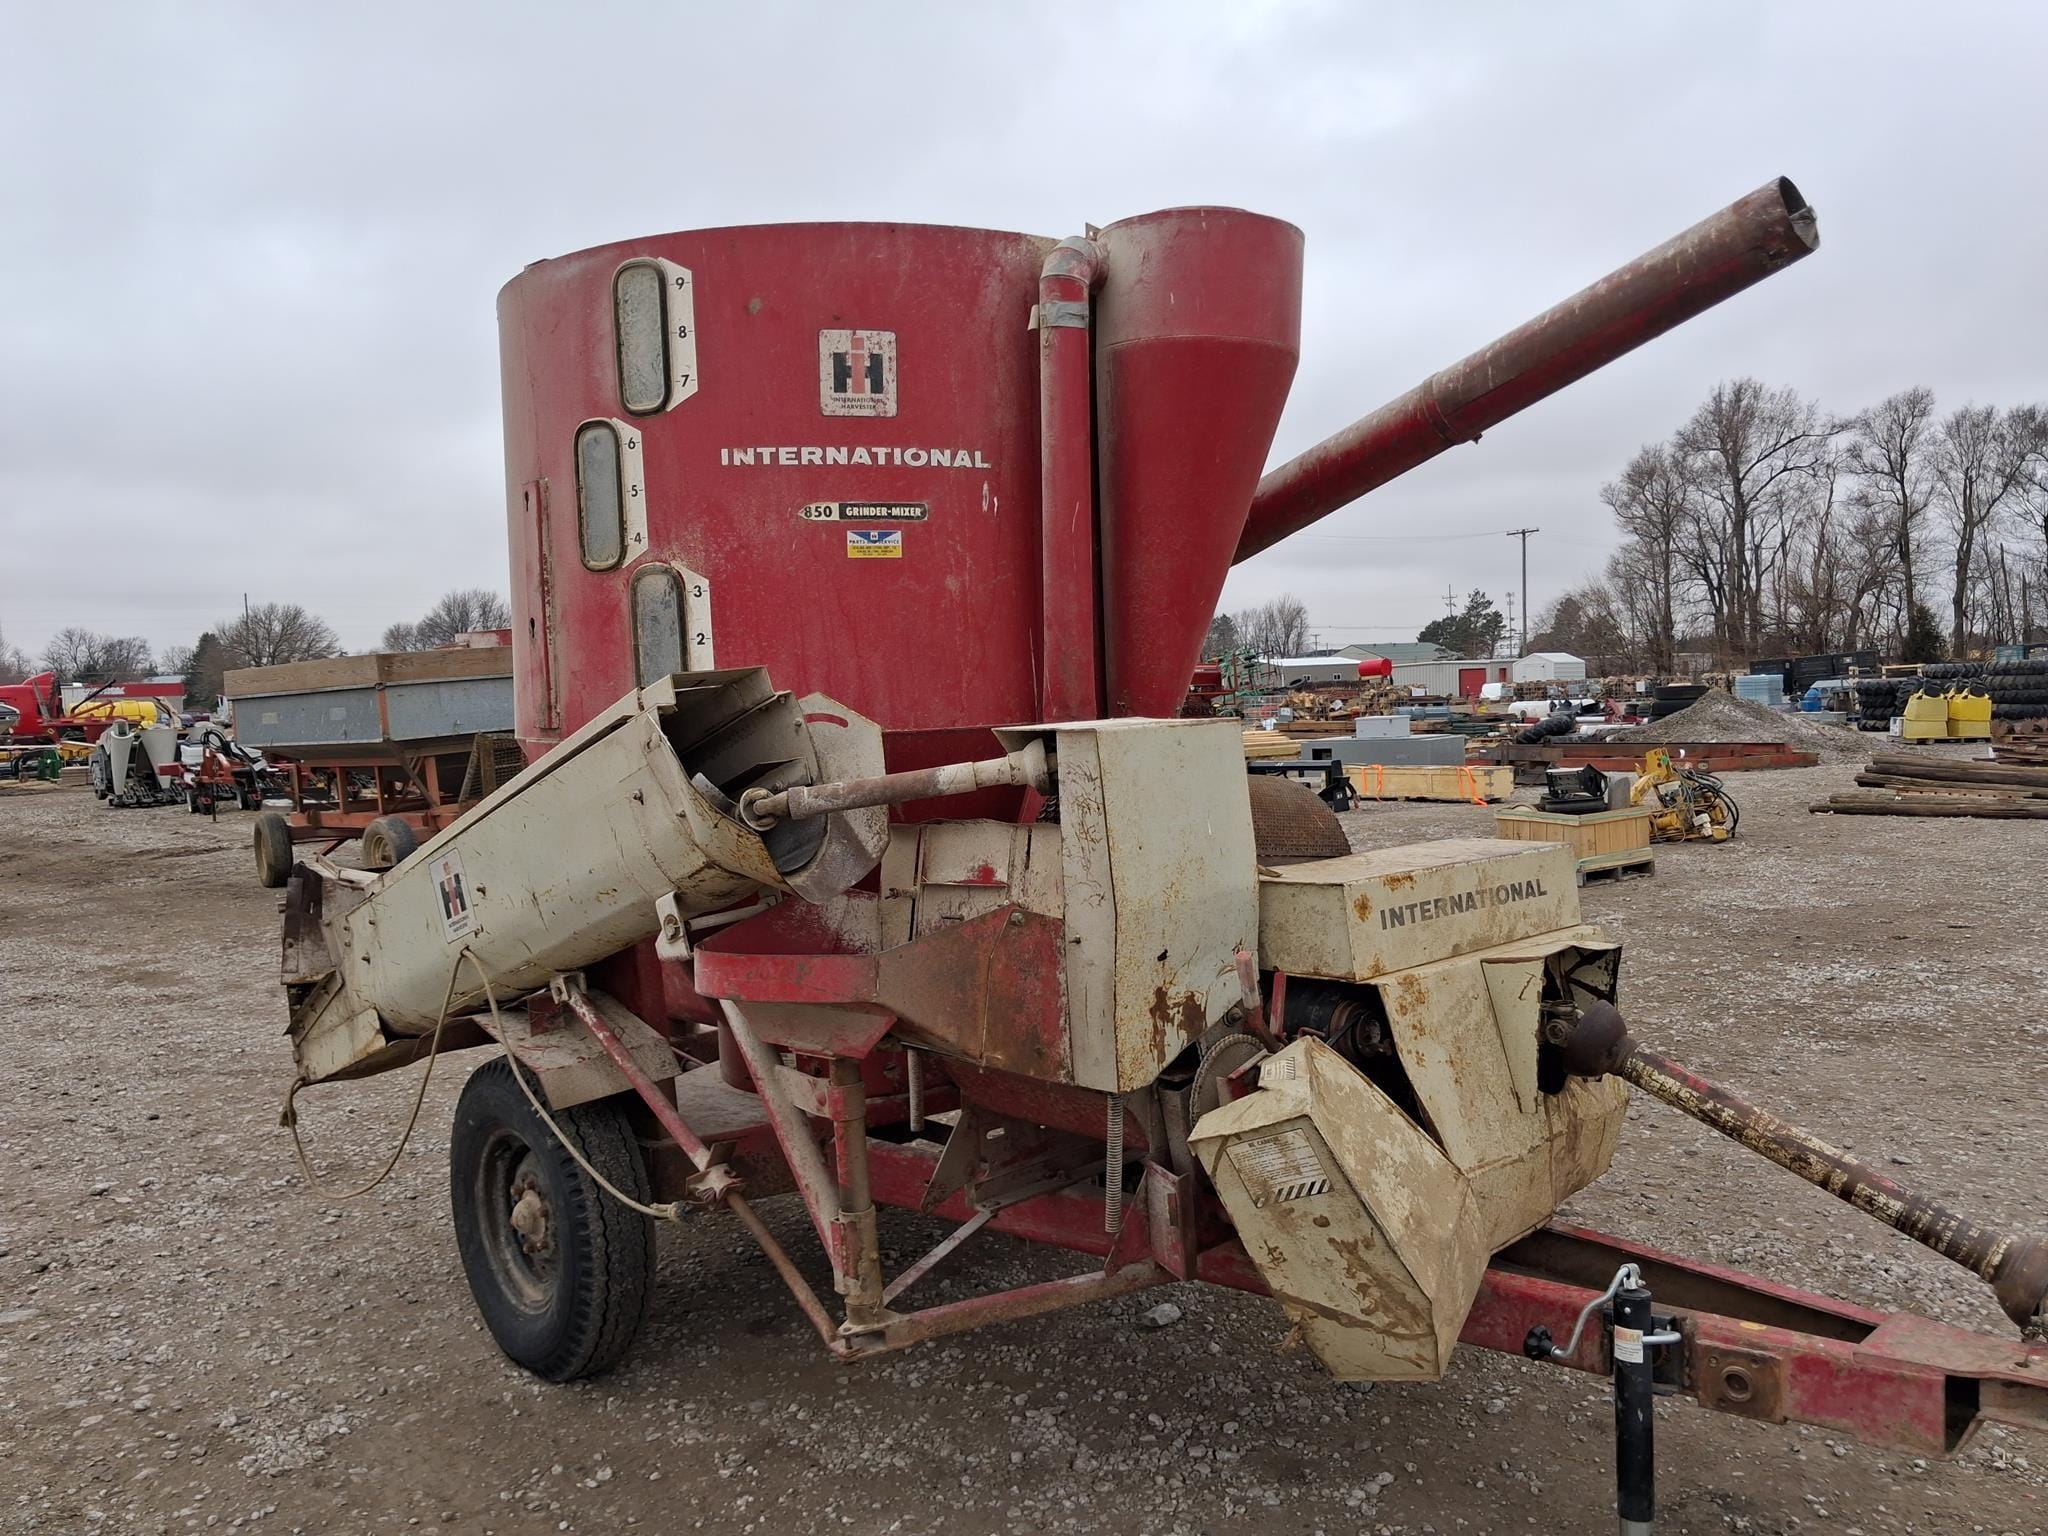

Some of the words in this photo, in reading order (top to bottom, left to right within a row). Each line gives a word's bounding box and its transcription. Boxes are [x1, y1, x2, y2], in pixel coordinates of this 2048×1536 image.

[675, 276, 685, 291] 9
[678, 325, 688, 339] 8
[681, 373, 690, 388] 7
[627, 436, 637, 451] 6
[721, 446, 992, 469] INTERNATIONAL
[630, 484, 639, 498] 5
[804, 505, 833, 518] 850
[845, 506, 922, 518] GRINDER-MIXER
[633, 532, 643, 546] 4
[692, 584, 703, 598] 3
[696, 632, 706, 647] 2
[1380, 878, 1548, 931] INTERNATIONAL
